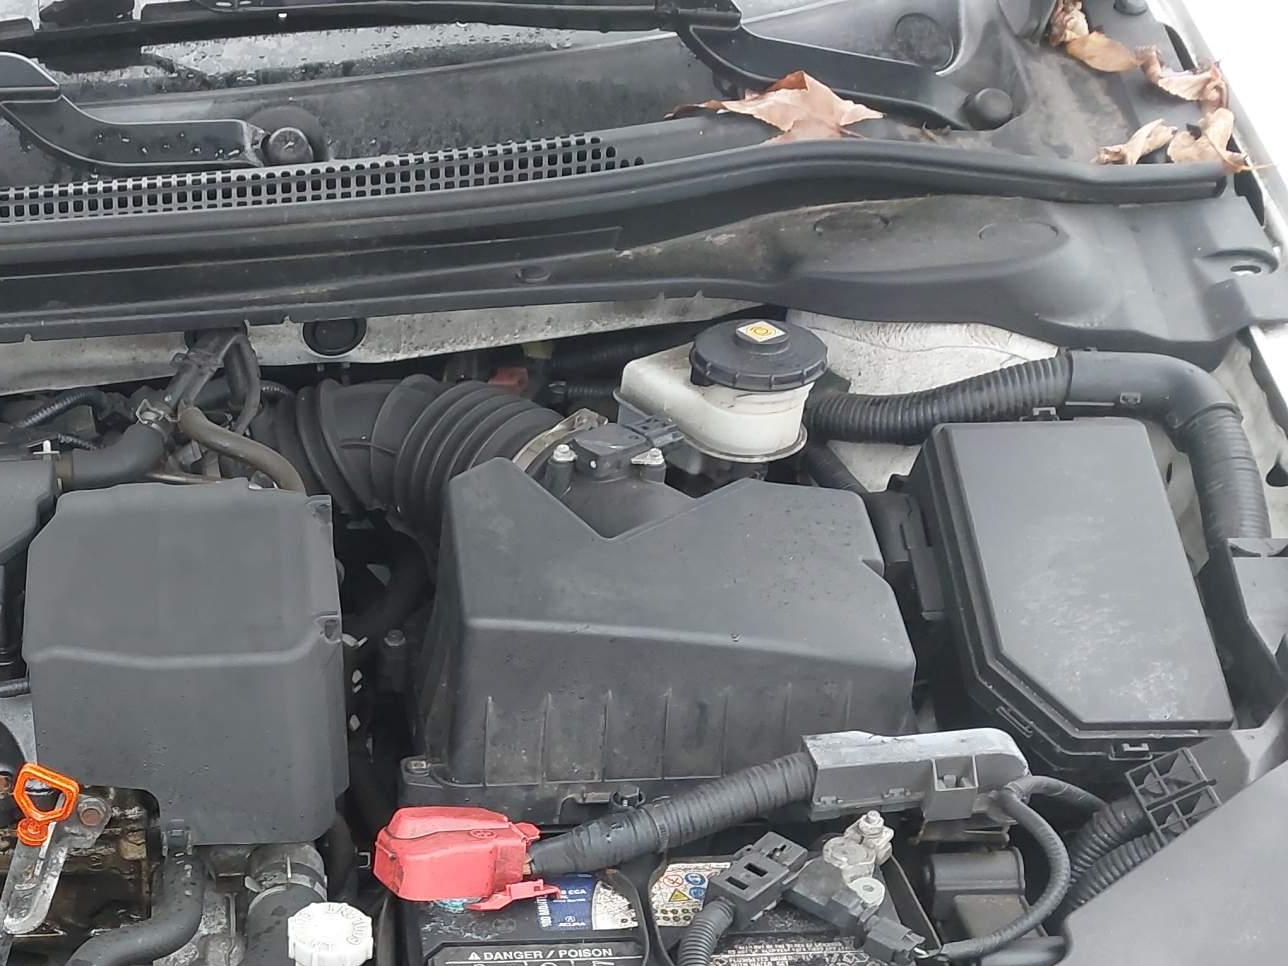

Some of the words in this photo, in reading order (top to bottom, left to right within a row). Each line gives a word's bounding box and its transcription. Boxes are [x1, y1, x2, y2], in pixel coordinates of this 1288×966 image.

[483, 950, 543, 960] DANGER
[546, 950, 555, 959] /
[558, 948, 613, 958] POISON
